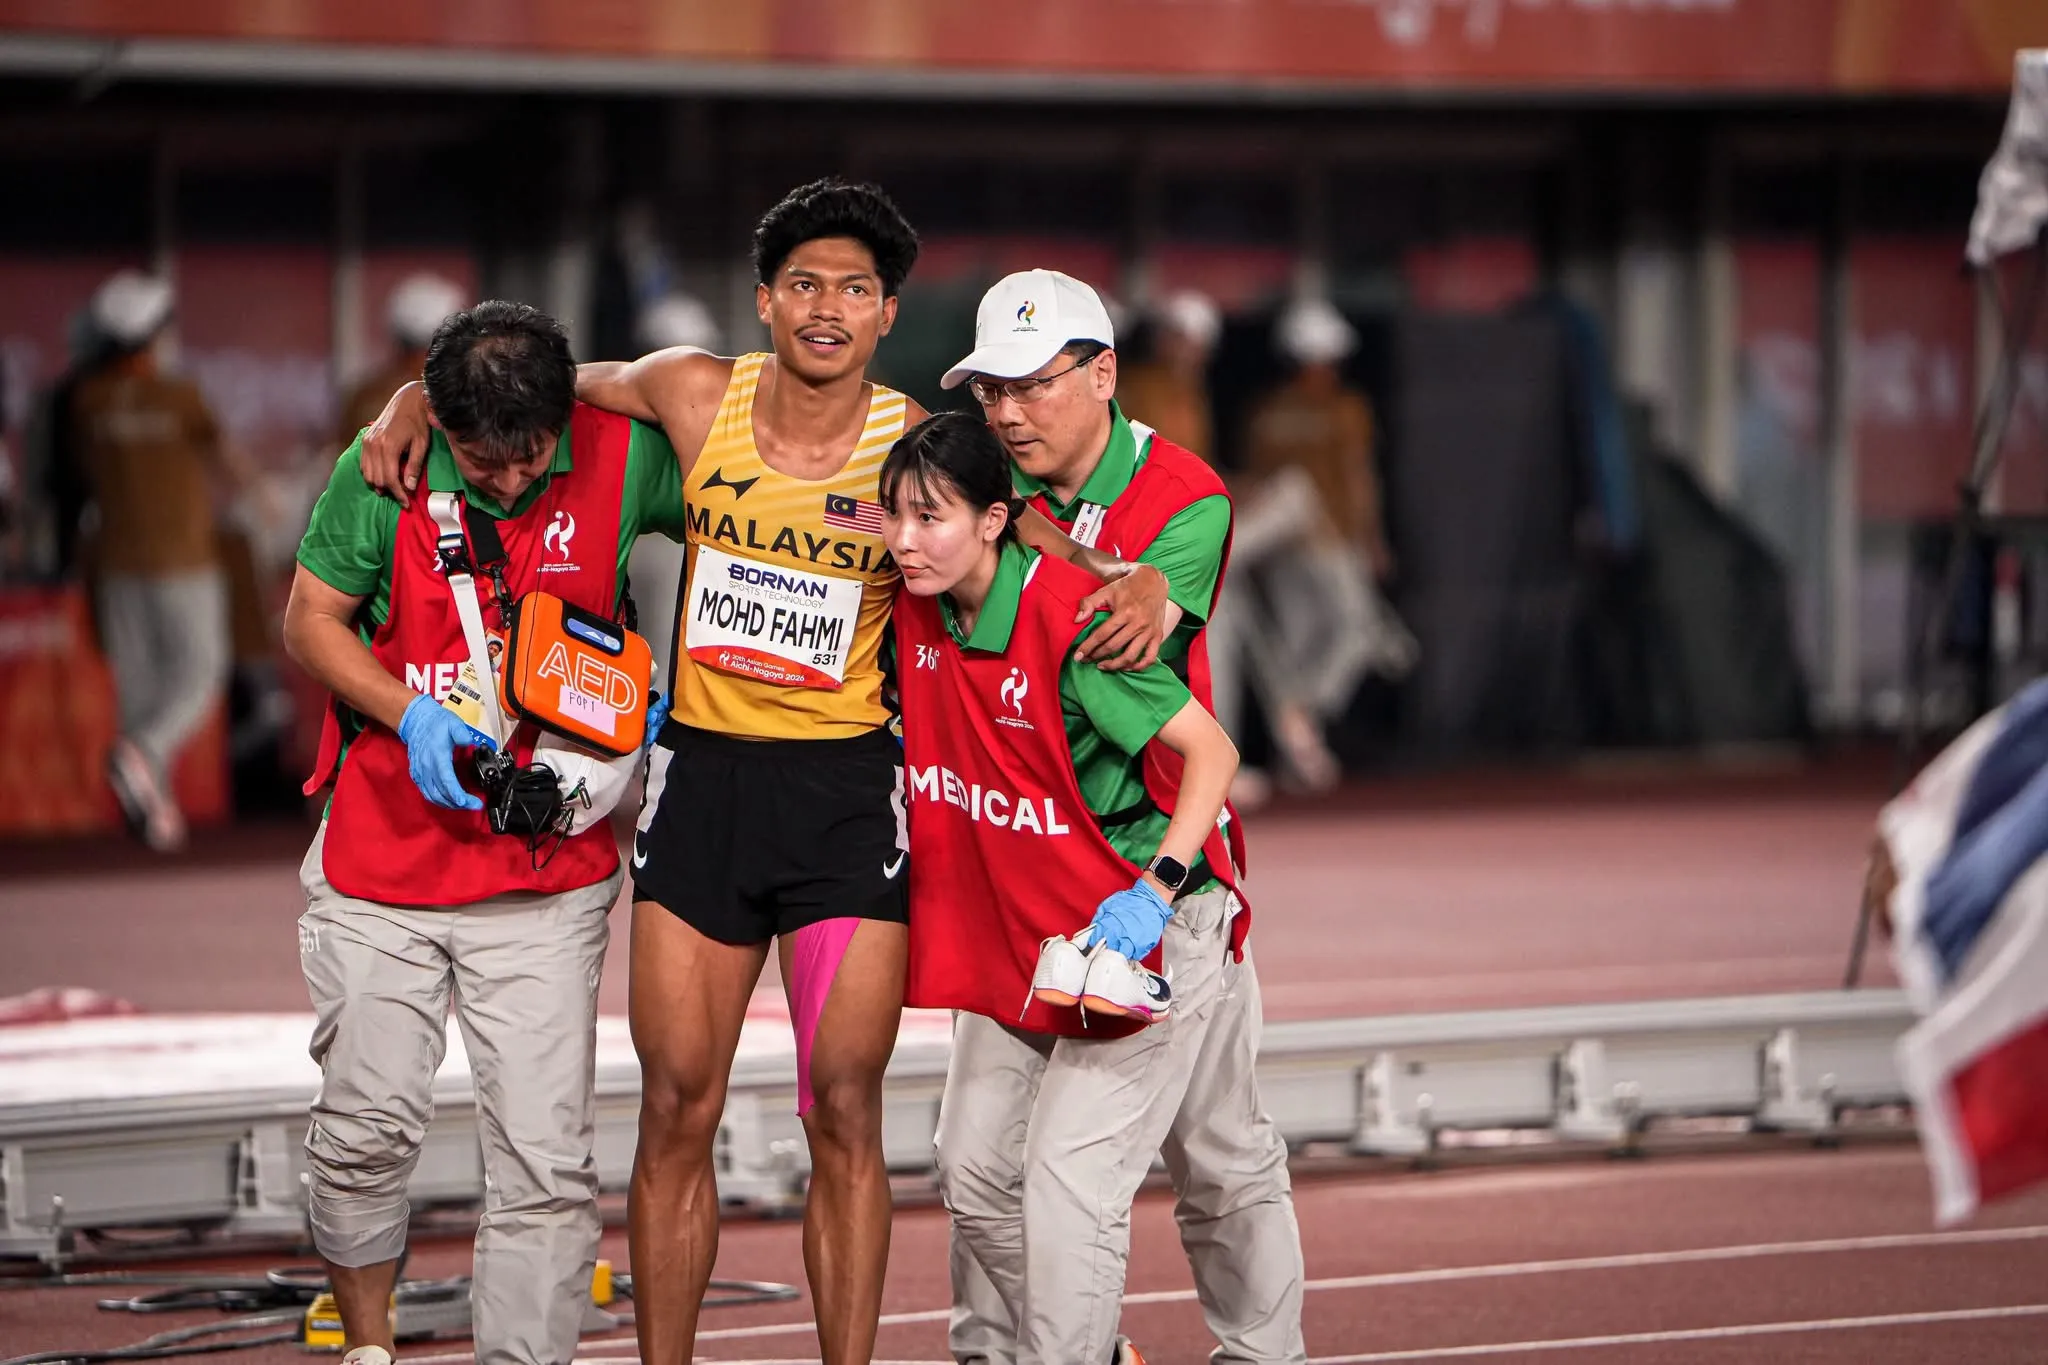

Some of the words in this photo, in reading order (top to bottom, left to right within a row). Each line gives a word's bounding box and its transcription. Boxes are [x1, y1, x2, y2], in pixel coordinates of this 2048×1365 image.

[687, 502, 898, 573] MALAYSIA
[727, 563, 828, 599] BORNAN
[728, 580, 760, 596] SPORTS
[764, 590, 824, 608] TECHNOLOGY
[697, 587, 765, 637] MOHD
[769, 607, 844, 652] FAHMI
[537, 641, 638, 714] AED
[747, 657, 763, 667] Asian
[764, 661, 785, 672] Games
[785, 673, 805, 682] 2026
[812, 653, 838, 666] 531
[909, 765, 1070, 835] MEDICAL
